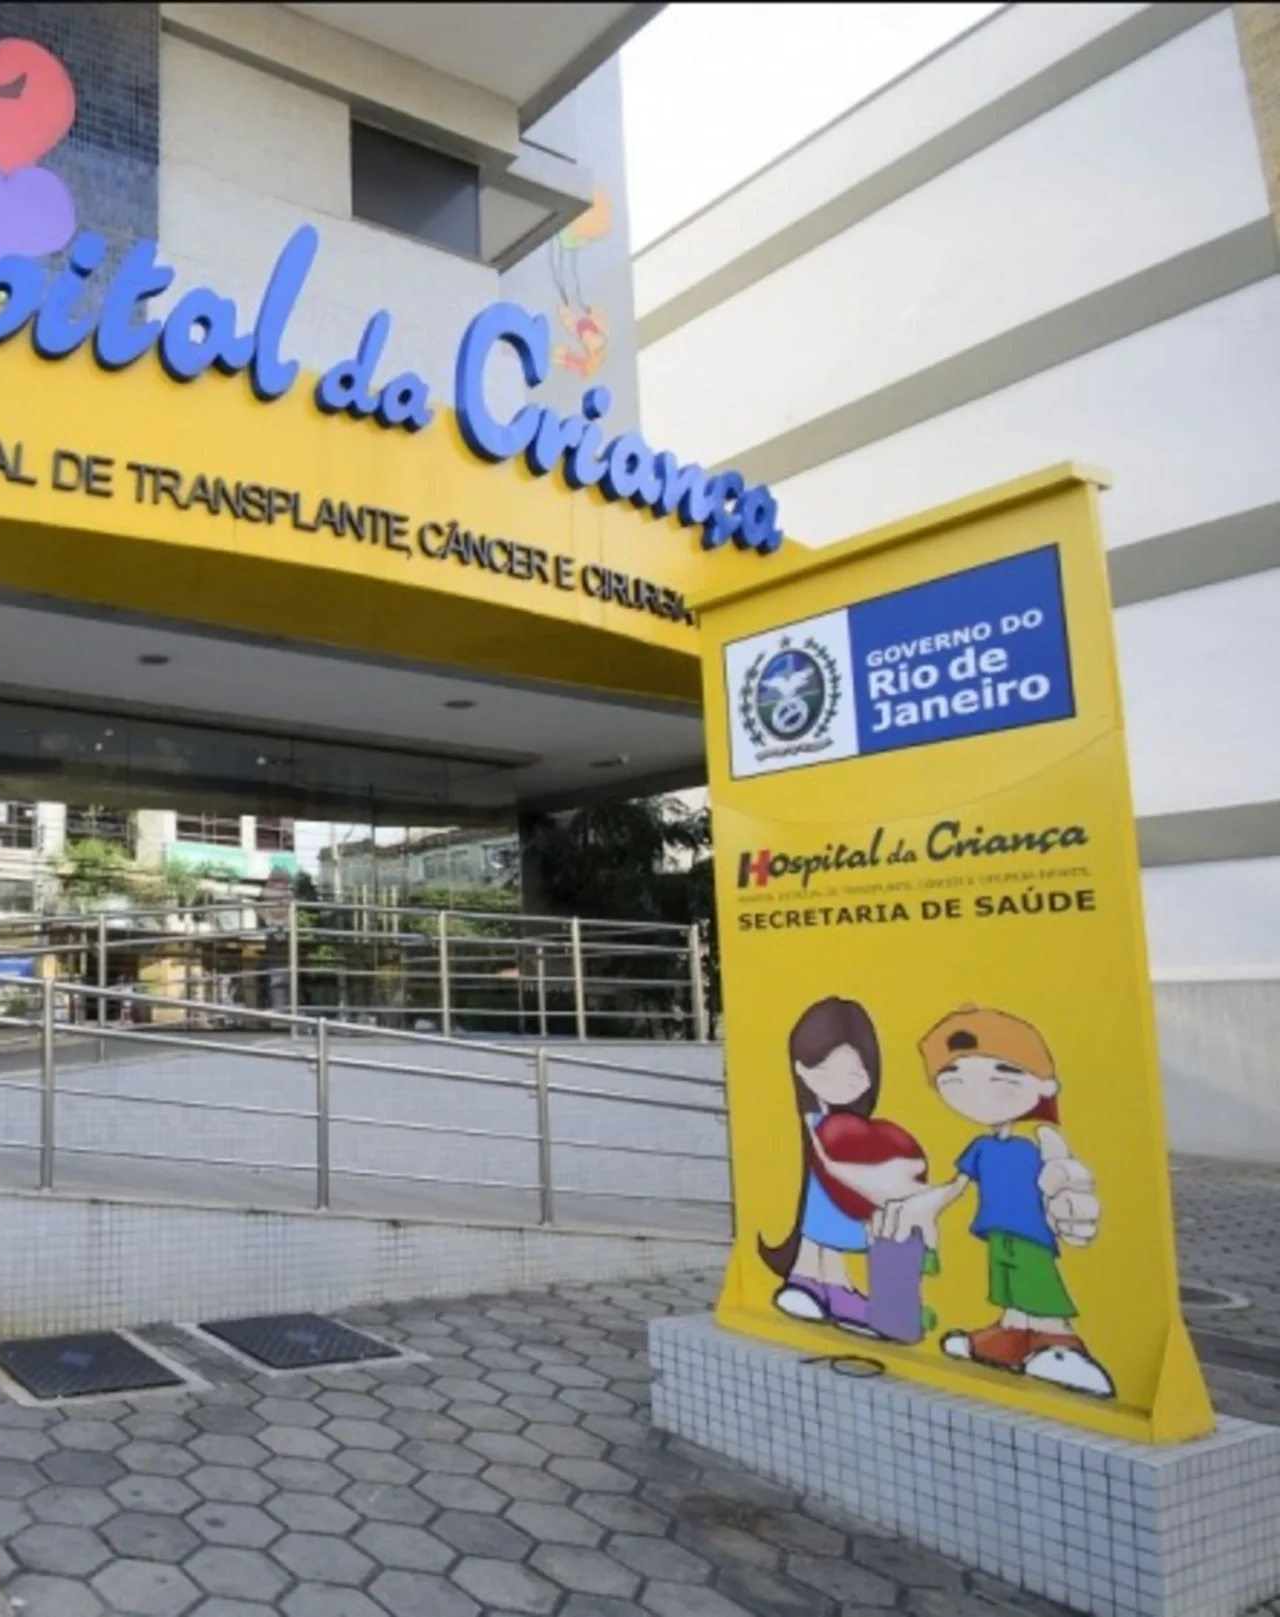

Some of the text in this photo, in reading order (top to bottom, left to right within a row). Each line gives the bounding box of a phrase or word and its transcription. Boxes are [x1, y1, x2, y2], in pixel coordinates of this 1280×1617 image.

[314, 310, 433, 432] da
[455, 301, 783, 556] Criança
[51, 449, 115, 498] DE
[127, 460, 411, 561] TRANSPLANTE,
[419, 518, 548, 586] CÂNCER
[555, 551, 576, 591] E
[866, 608, 1043, 668] GOVERNO DO
[867, 646, 1009, 700] Rio de
[872, 673, 1051, 732] Janeiro
[737, 827, 884, 888] Hospital
[886, 839, 917, 865] da
[926, 821, 1089, 863] Criança
[738, 885, 1096, 931] SECRETARIA DE SAÚDE
